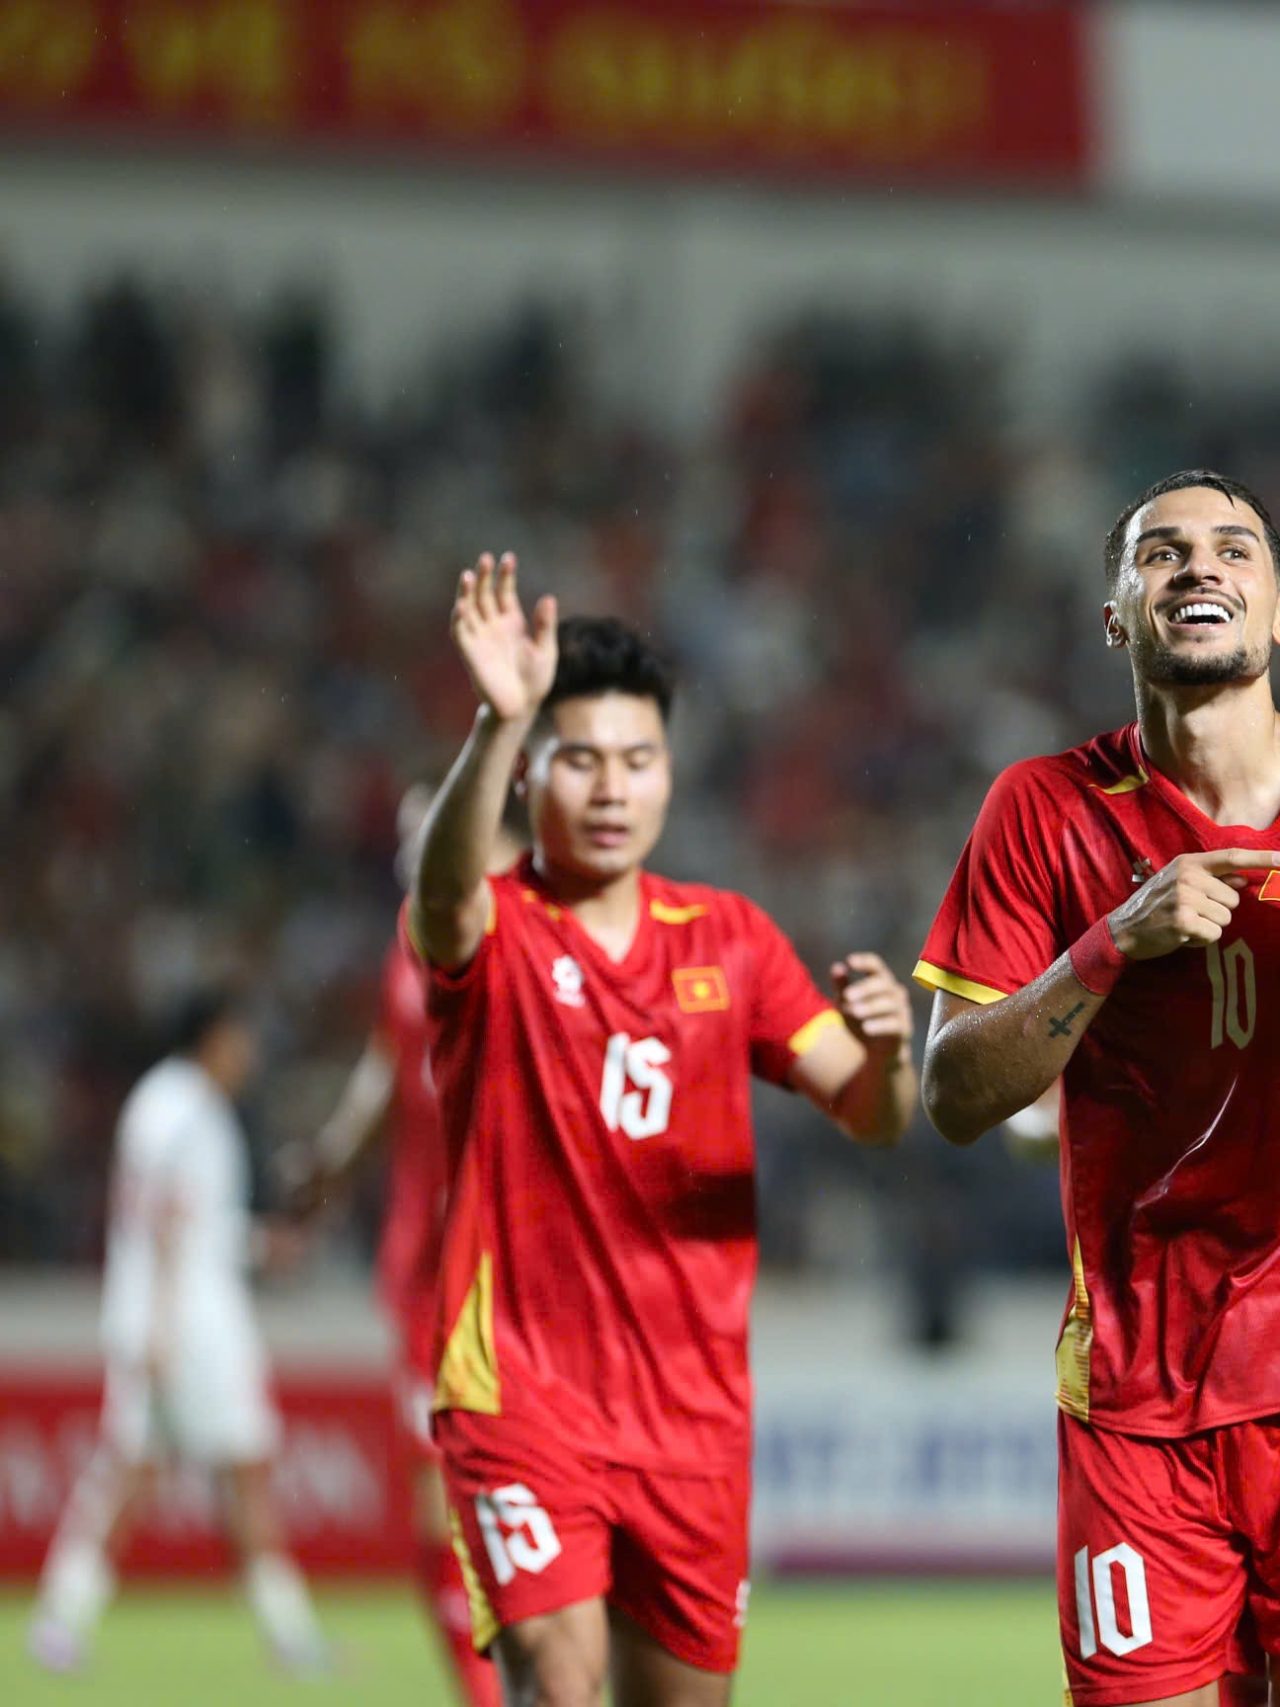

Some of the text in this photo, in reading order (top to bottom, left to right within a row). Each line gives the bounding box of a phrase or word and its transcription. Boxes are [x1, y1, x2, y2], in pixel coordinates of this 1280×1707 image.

[1206, 938, 1257, 1050] 10
[600, 1031, 673, 1141] 15
[475, 1483, 562, 1586] 15
[1073, 1541, 1154, 1661] 10
